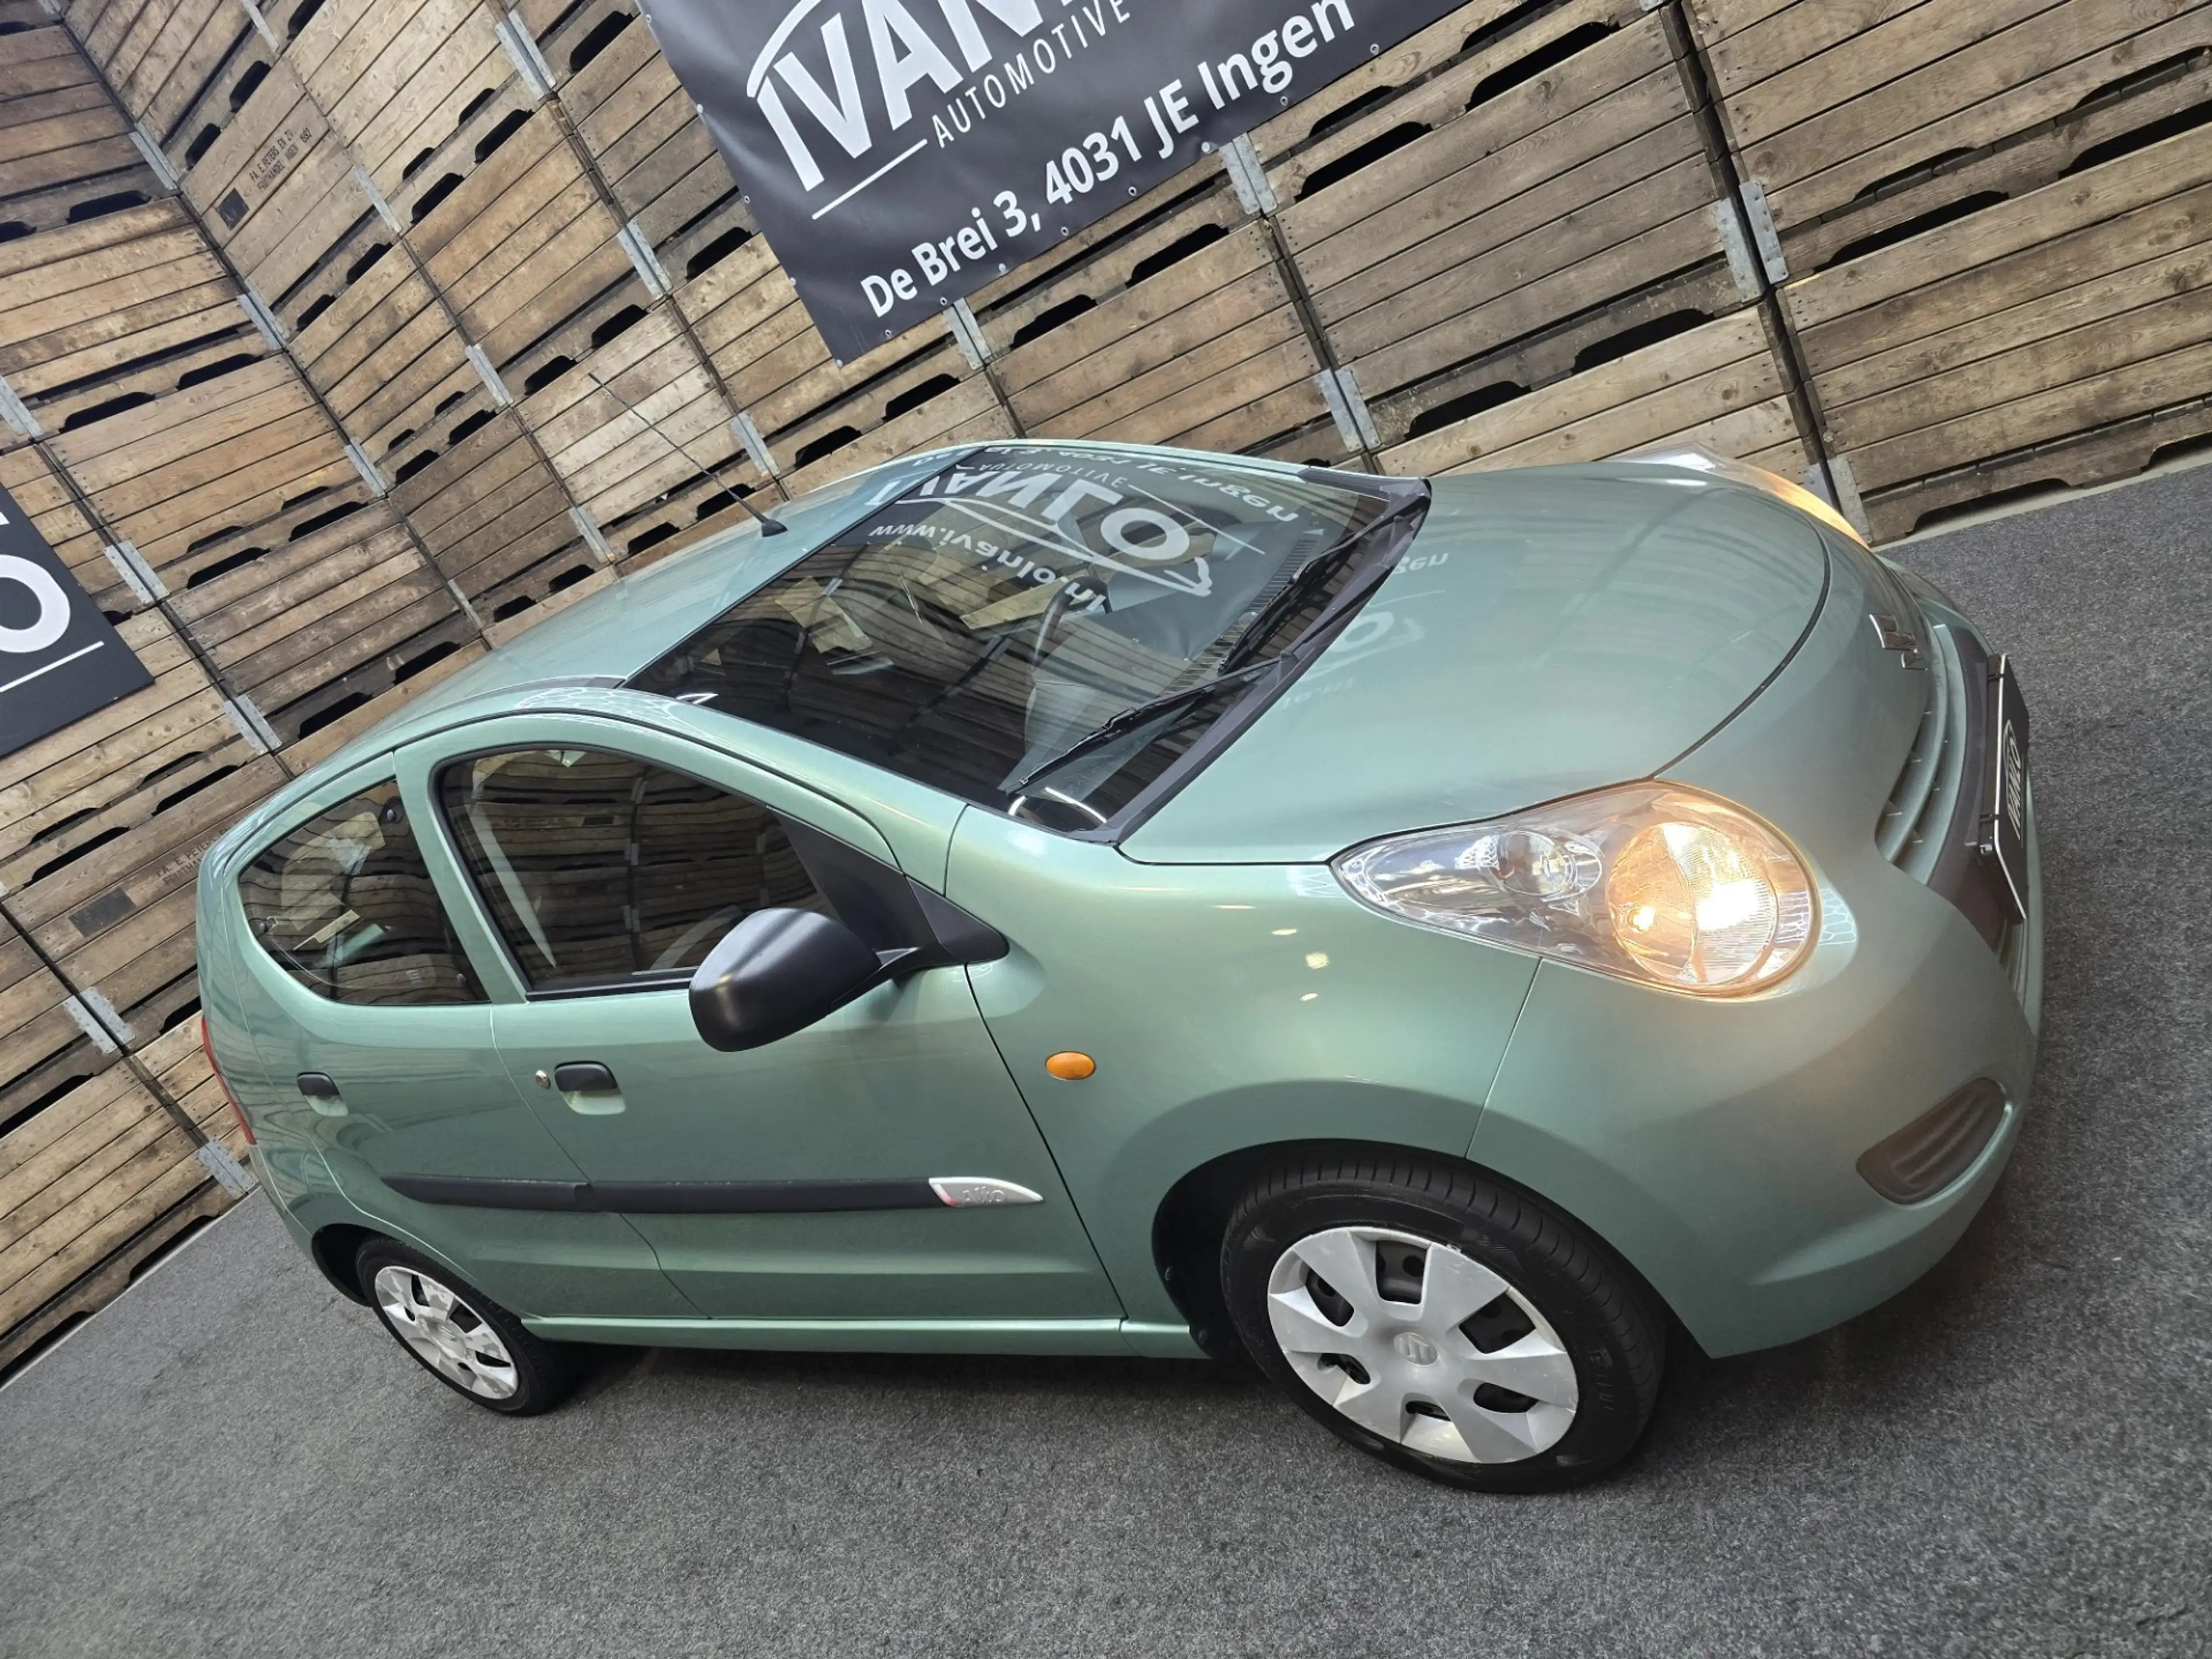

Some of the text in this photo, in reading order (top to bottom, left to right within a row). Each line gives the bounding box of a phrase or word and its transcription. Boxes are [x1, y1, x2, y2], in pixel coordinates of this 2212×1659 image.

[757, 0, 1073, 191] IVAN
[861, 0, 1355, 318] De Brei 3, 4031 JE Ingen
[931, 0, 1130, 149] AUTOMOTIVE
